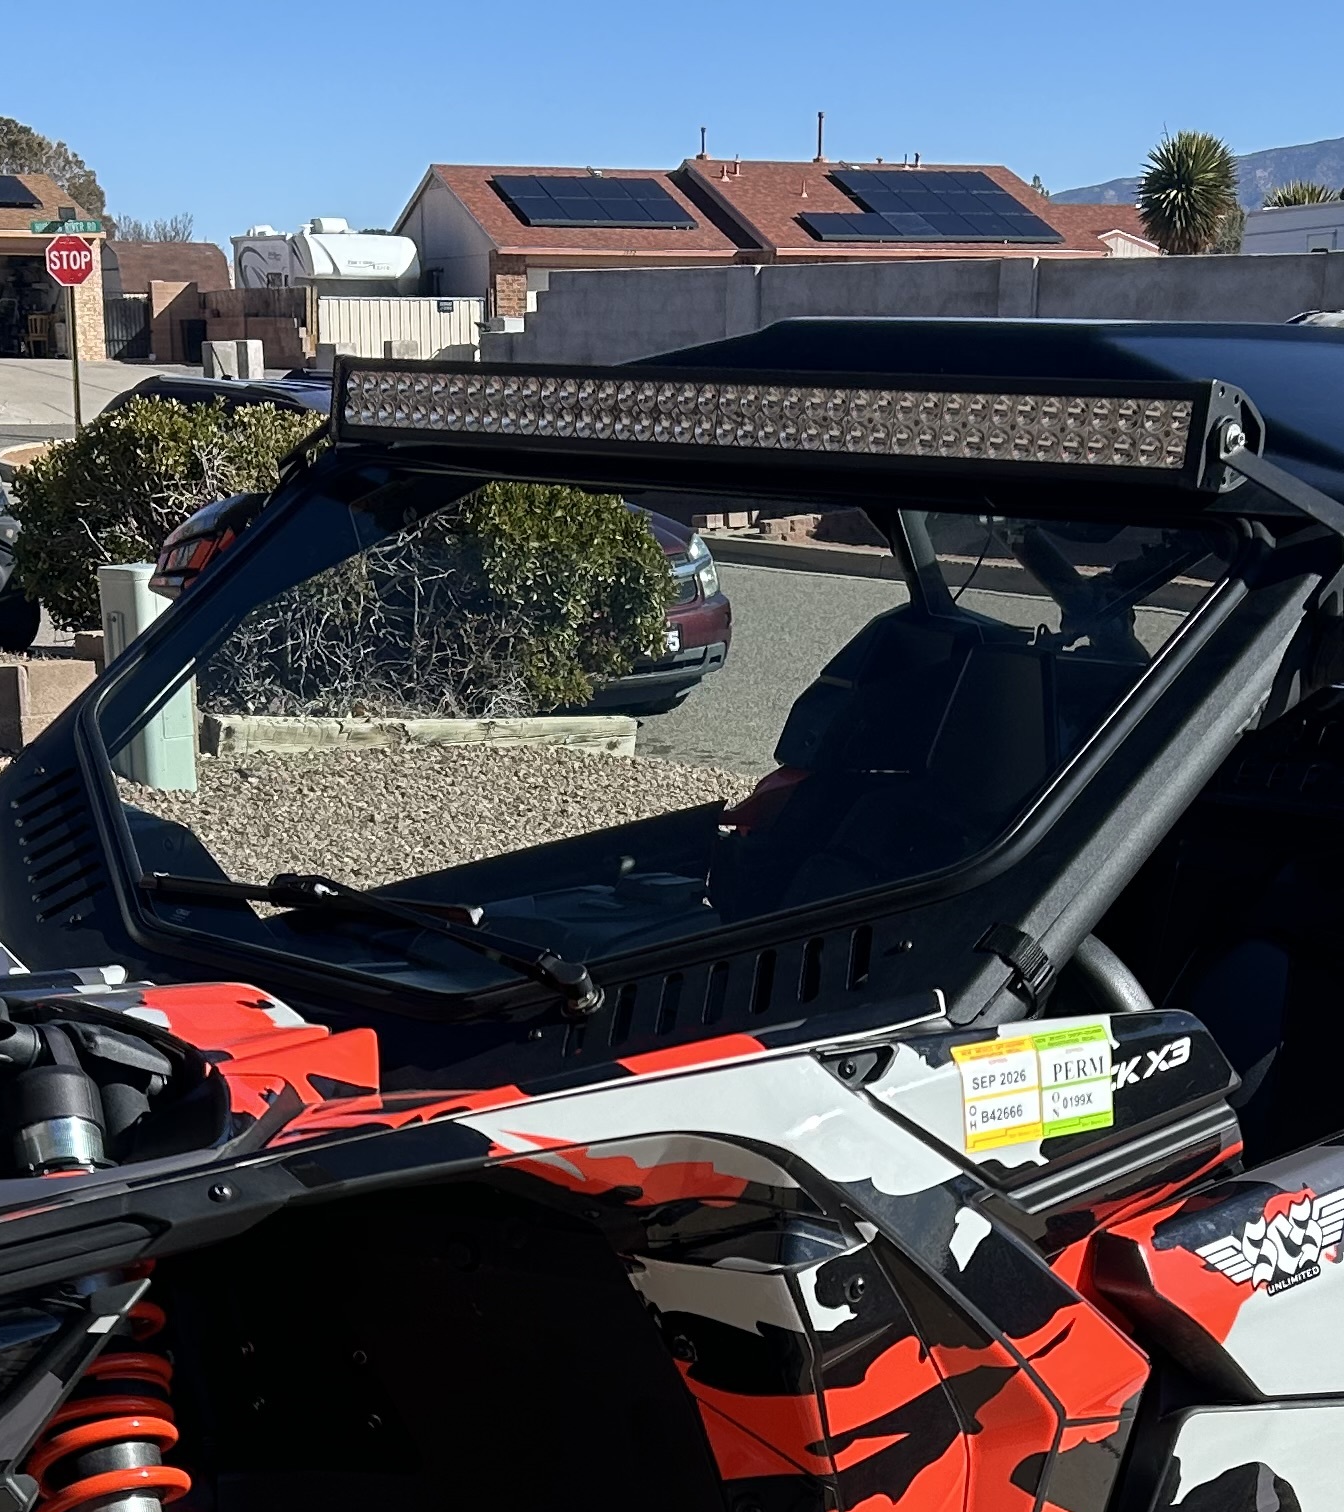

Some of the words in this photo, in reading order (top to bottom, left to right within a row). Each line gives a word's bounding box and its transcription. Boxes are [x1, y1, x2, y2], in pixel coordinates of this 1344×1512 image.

[49, 250, 91, 271] STOP
[1053, 1056, 1104, 1083] PERM
[1143, 1036, 1191, 1080] X3
[972, 1074, 996, 1091] SEP
[1000, 1068, 1027, 1086] 2026
[981, 1104, 1023, 1124] B42666
[1267, 1265, 1321, 1294] UNLIMITED
